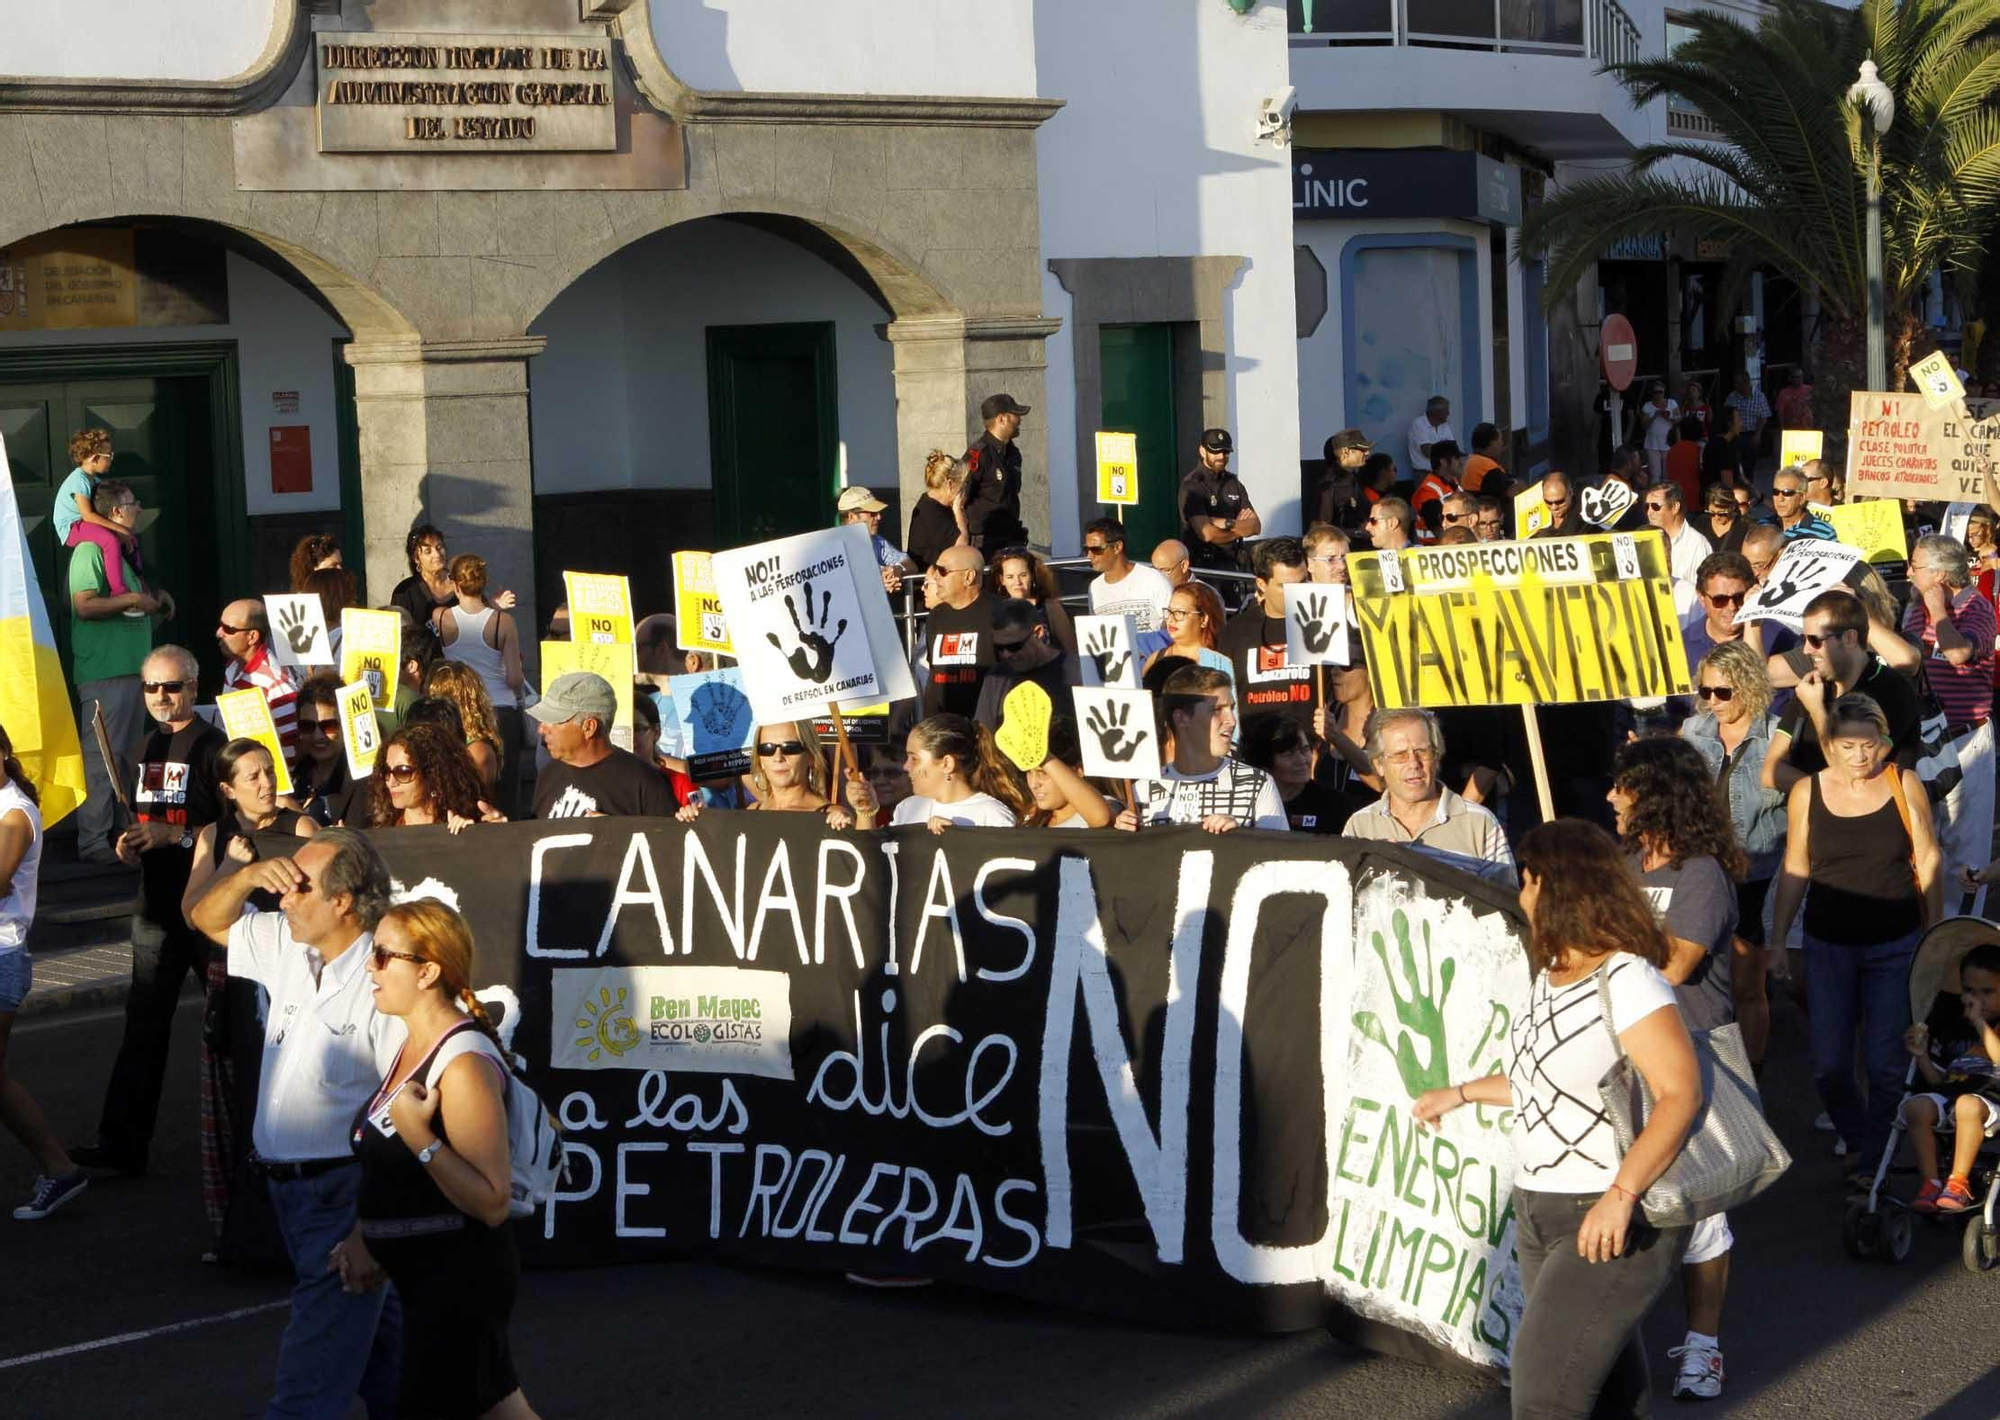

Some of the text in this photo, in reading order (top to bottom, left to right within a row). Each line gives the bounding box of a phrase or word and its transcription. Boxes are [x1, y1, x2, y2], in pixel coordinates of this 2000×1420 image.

[541, 50, 573, 69] DE
[579, 51, 609, 70] LA
[405, 116, 536, 139] DEL ESTADO
[1921, 361, 1941, 376] NO
[1861, 420, 1920, 439] PETROLEO
[1943, 422, 1960, 438] EL
[1859, 440, 1891, 453] CLASE
[1112, 466, 1125, 475] NO
[1815, 510, 1832, 523] NO
[745, 555, 782, 588] NO!!
[1417, 542, 1579, 580] PROSPECCIONES
[758, 583, 775, 599] LAS
[775, 554, 845, 592] PERFORACIONES
[592, 619, 612, 632] NO
[364, 656, 382, 669] NO
[782, 672, 874, 706] DE REPSOL EN CANARIAS
[1290, 684, 1310, 702] NO
[352, 693, 368, 714] NO
[527, 828, 1036, 983] CANARIAS
[650, 995, 761, 1021] Ben Magec
[806, 988, 1018, 1136] dice
[1038, 849, 1355, 1285] NO
[559, 1068, 750, 1135] a las
[543, 1142, 1040, 1268] PETROLERAS
[1333, 1199, 1510, 1356] LIMPIAS
